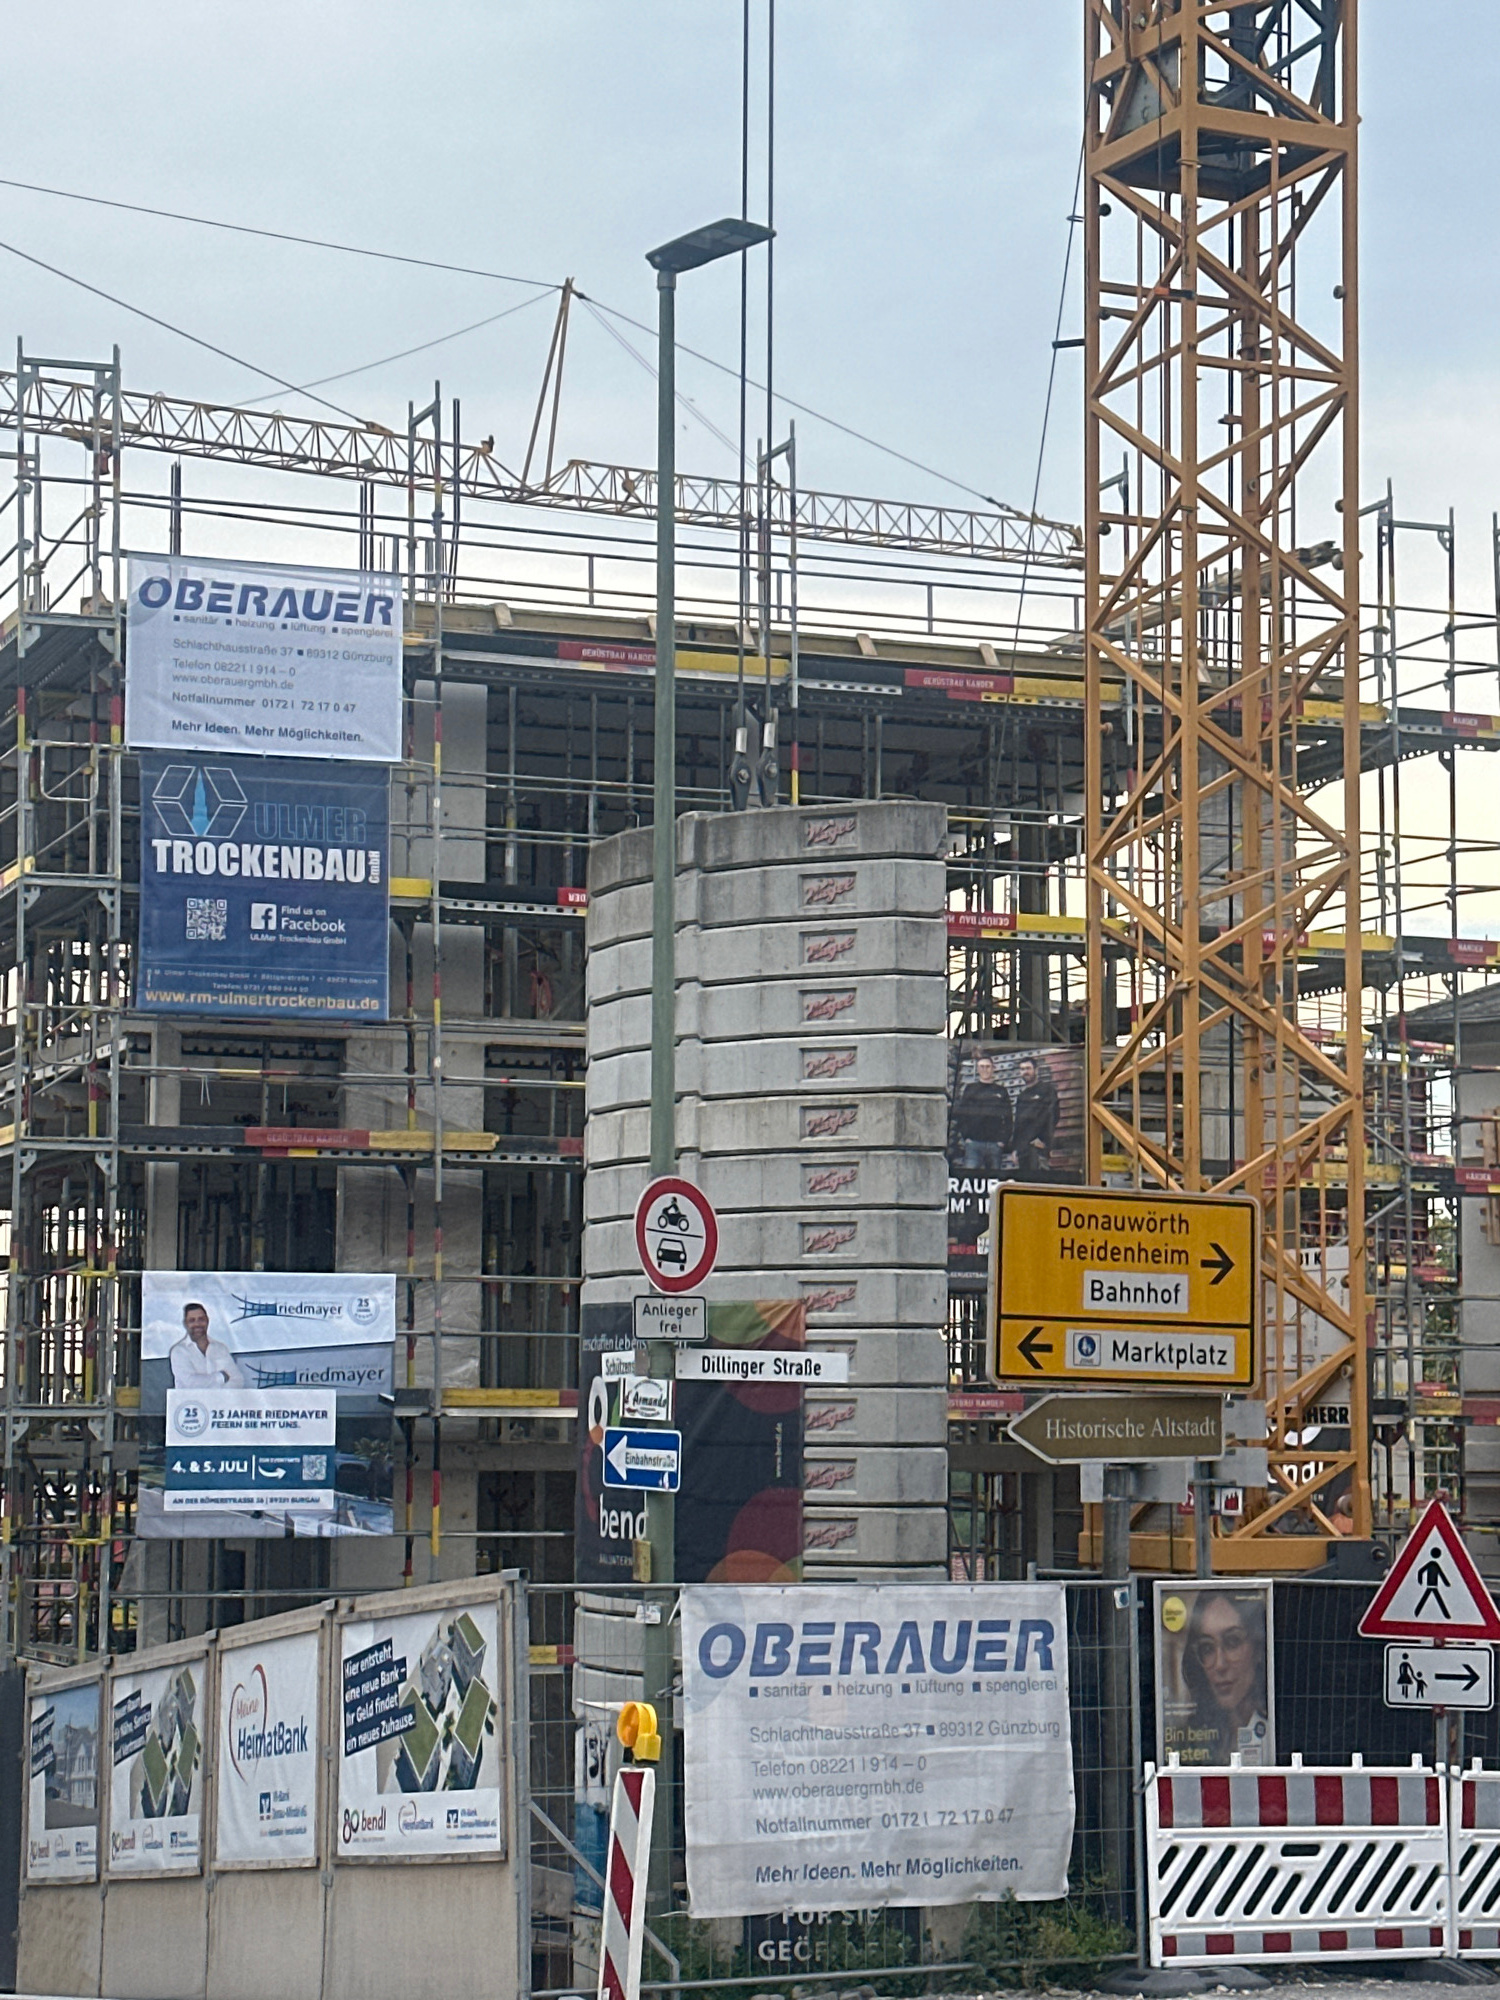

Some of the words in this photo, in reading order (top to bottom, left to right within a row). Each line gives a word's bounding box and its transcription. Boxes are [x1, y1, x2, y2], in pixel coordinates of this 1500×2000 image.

[138, 576, 394, 626] OBERAUER
[183, 614, 218, 625] sanitär
[236, 618, 275, 630] heizung
[291, 621, 326, 634] lüftung
[341, 627, 393, 639] spenglerei
[173, 639, 277, 656] Schlachthausstraße
[280, 646, 293, 656] 37
[306, 648, 339, 660] 89312
[342, 650, 393, 665] Günzburg
[173, 658, 211, 671] Telefon
[214, 661, 246, 673] 08221
[256, 664, 276, 675] 914
[288, 667, 296, 676] 0
[172, 672, 294, 690] www.oberauergmbh.de
[172, 691, 255, 707] Notfallnummer
[262, 697, 288, 709] 0172
[301, 700, 314, 711] 72
[317, 701, 330, 711] 17
[333, 702, 340, 712] 0
[343, 703, 357, 713] 47
[171, 720, 202, 732] Mehr
[205, 722, 241, 735] Ideen.
[245, 724, 275, 737] Mehr
[278, 727, 364, 744] Möglichkeiten.
[254, 803, 367, 844] ULMER
[151, 838, 366, 883] TROCKENBAU
[281, 905, 301, 916] Find
[303, 908, 313, 916] us
[315, 908, 327, 916] on
[281, 918, 346, 933] Facebook
[279, 934, 321, 944] Trockenbau
[145, 990, 379, 1011] www.rm-ulmertrockenbau.de
[1058, 1206, 1190, 1235] Donauwörth
[1059, 1238, 1190, 1265] Heidenheim
[357, 1298, 369, 1307] 25
[1090, 1279, 1182, 1305] Bahnhof
[278, 1301, 343, 1320] riedmayer
[642, 1303, 698, 1328] Anlieger
[659, 1317, 683, 1333] frei
[701, 1355, 765, 1376] Dillinger
[773, 1357, 822, 1377] Straße
[1112, 1340, 1228, 1370] Marktplatz
[299, 1366, 385, 1386] riedmayer
[184, 1408, 198, 1417] 25
[211, 1410, 224, 1419] 25
[227, 1410, 263, 1419] JAHRE
[265, 1410, 328, 1419] RIEDMAYER
[211, 1421, 242, 1429] FEIERN
[244, 1421, 258, 1429] SIE
[260, 1421, 277, 1429] MIT
[279, 1421, 301, 1429] UNS.
[1045, 1418, 1145, 1439] Historische
[1150, 1418, 1217, 1438] Altstadt
[172, 1460, 187, 1473] 4.
[190, 1460, 200, 1473] &
[203, 1461, 216, 1473] 5.
[219, 1460, 248, 1473] JULI
[625, 1451, 675, 1469] Einbahnstraße
[599, 1492, 647, 1540] bend
[698, 1619, 1055, 1679] OBERAUER
[344, 1658, 361, 1677] Hier
[361, 1645, 393, 1671] entsteht
[345, 1686, 360, 1703] eine
[361, 1678, 380, 1697] neue
[380, 1668, 400, 1687] Bank
[763, 1682, 812, 1698] sanitär
[837, 1681, 893, 1698] heizung
[915, 1678, 964, 1696] lüftung
[985, 1677, 1058, 1694] spenglerei
[356, 1701, 374, 1723] Geld
[375, 1690, 399, 1714] findet
[237, 1715, 308, 1761] HeimatBank
[346, 1735, 357, 1752] ein
[358, 1727, 380, 1747] neues
[381, 1714, 416, 1739] Zuhause.
[750, 1723, 900, 1744] Schlachthausstraße
[903, 1723, 921, 1737] 37
[938, 1721, 984, 1737] 89312
[988, 1719, 1061, 1738] Günzburg
[1165, 1727, 1185, 1742] Bin
[1188, 1725, 1219, 1741] beim
[752, 1760, 805, 1777] Telefon
[810, 1758, 857, 1775] 08221
[870, 1756, 898, 1772] 914
[917, 1756, 927, 1771] 0
[752, 1779, 925, 1800] www.oberauergmbh.de
[361, 1806, 387, 1831] bendl
[756, 1816, 871, 1834] Notfallnummer
[881, 1812, 920, 1829] 0172
[938, 1811, 958, 1827] 72
[962, 1810, 980, 1825] 17
[984, 1809, 994, 1825] 0
[997, 1808, 1014, 1824] 47
[756, 1864, 799, 1884] Mehr
[803, 1863, 856, 1881] Ideen.
[860, 1860, 901, 1879] Mehr
[906, 1855, 1024, 1878] Möglichkeiten.
